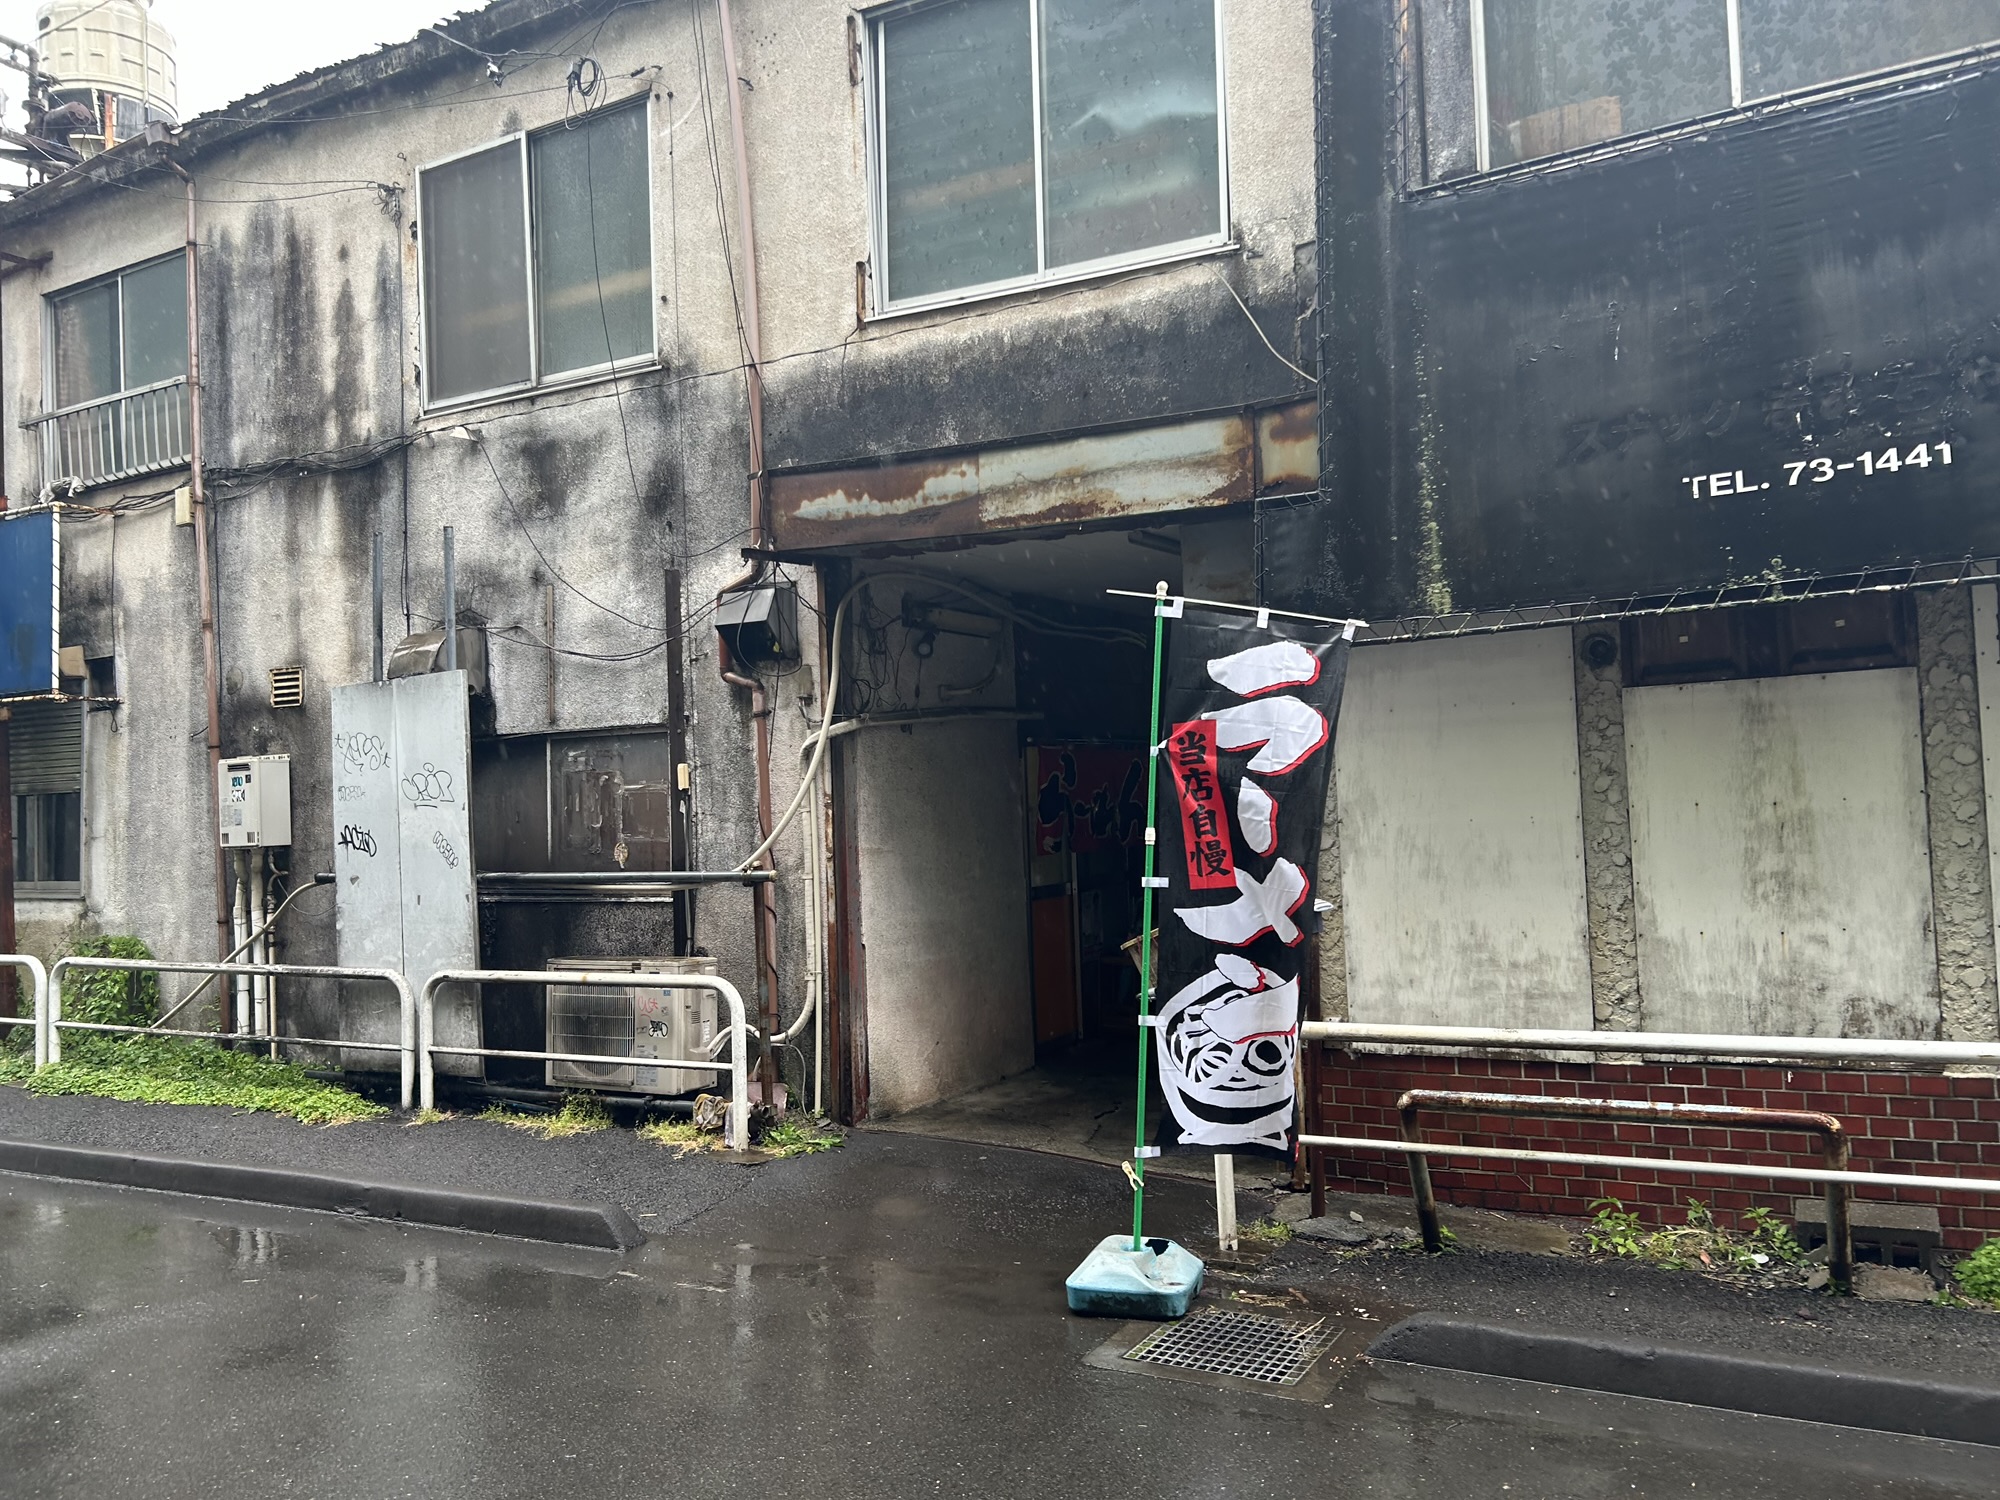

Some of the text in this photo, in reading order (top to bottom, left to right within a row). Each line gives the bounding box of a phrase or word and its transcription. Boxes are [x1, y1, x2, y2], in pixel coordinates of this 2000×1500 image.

[1682, 441, 1952, 499] TEL. 73-1441
[1037, 750, 1147, 855] らーめん
[1173, 641, 1328, 1045] ラーメン
[1177, 731, 1231, 877] 当店自慢
